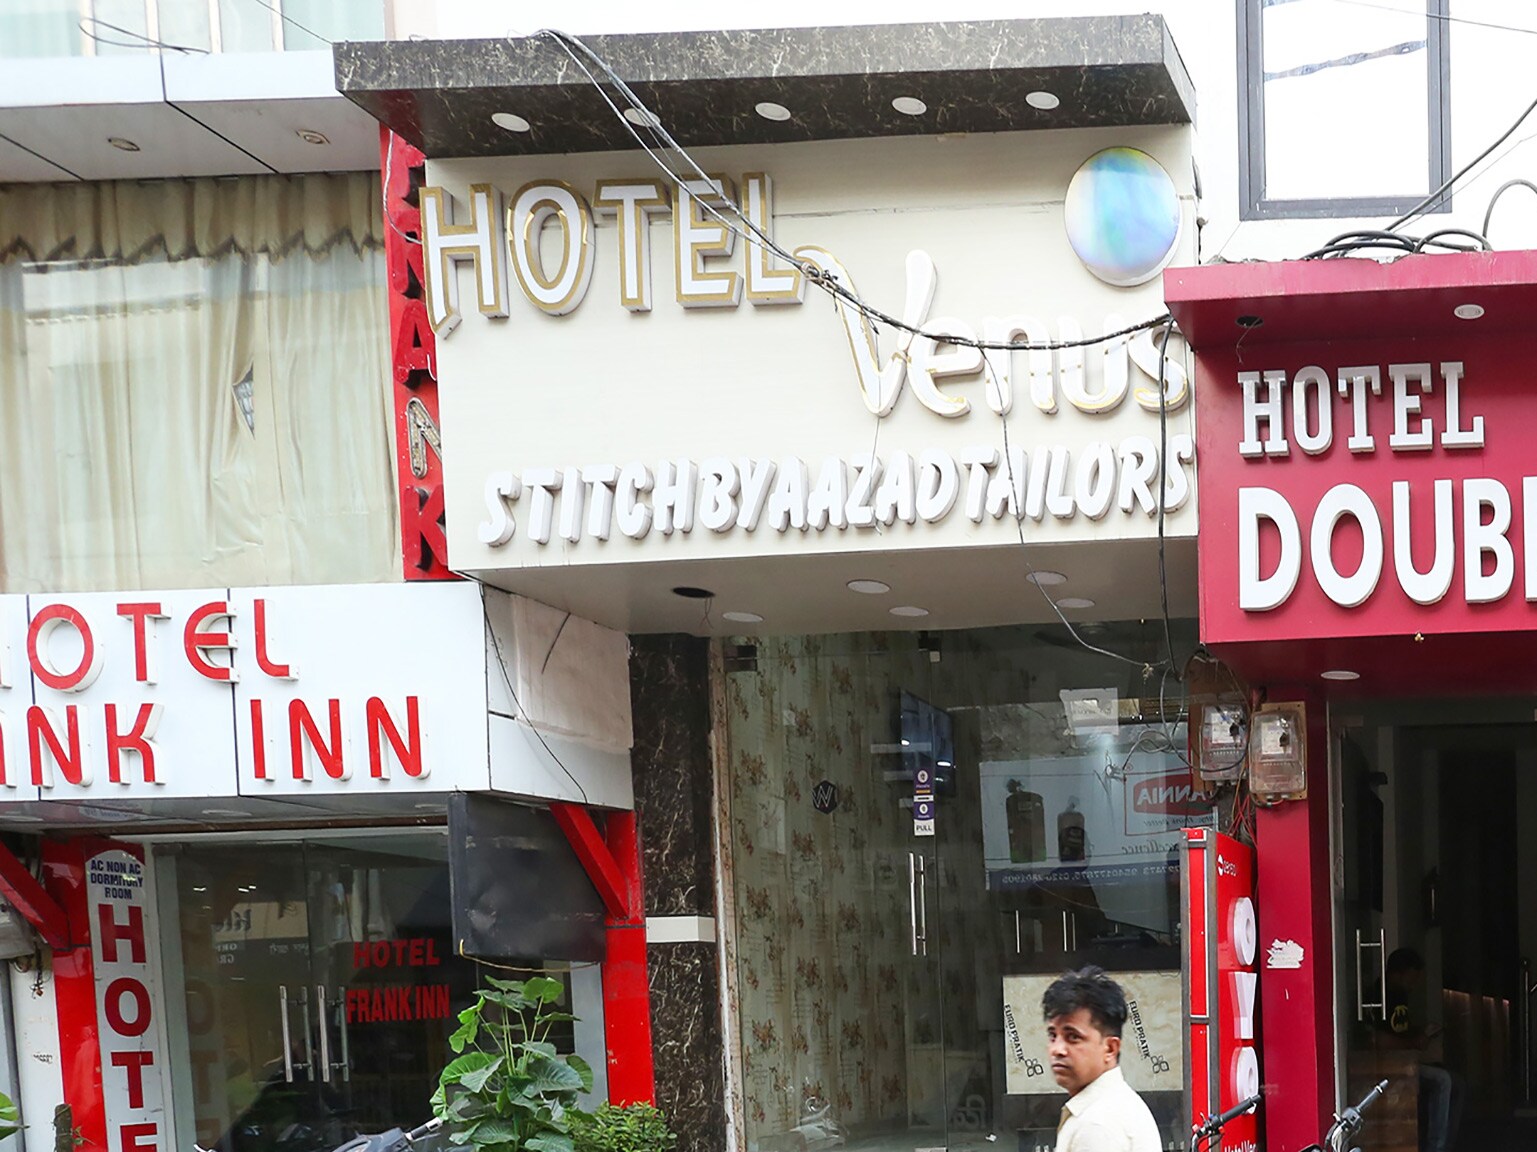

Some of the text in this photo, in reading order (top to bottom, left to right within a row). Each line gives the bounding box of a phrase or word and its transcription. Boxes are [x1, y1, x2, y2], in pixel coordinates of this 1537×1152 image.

[420, 172, 804, 338] HOTEL
[794, 245, 1190, 418] Venus
[1238, 361, 1485, 457] HOTEL
[0, 597, 299, 693] OTEL
[0, 695, 430, 788] NK INN
[90, 859, 141, 875] AC NON AC
[105, 887, 132, 899] ROOM
[353, 938, 441, 969] HOTEL
[346, 984, 450, 1024] FRANK INN
[1010, 1029, 1026, 1063] PRATIK
[1136, 1026, 1151, 1060] PRATIK
